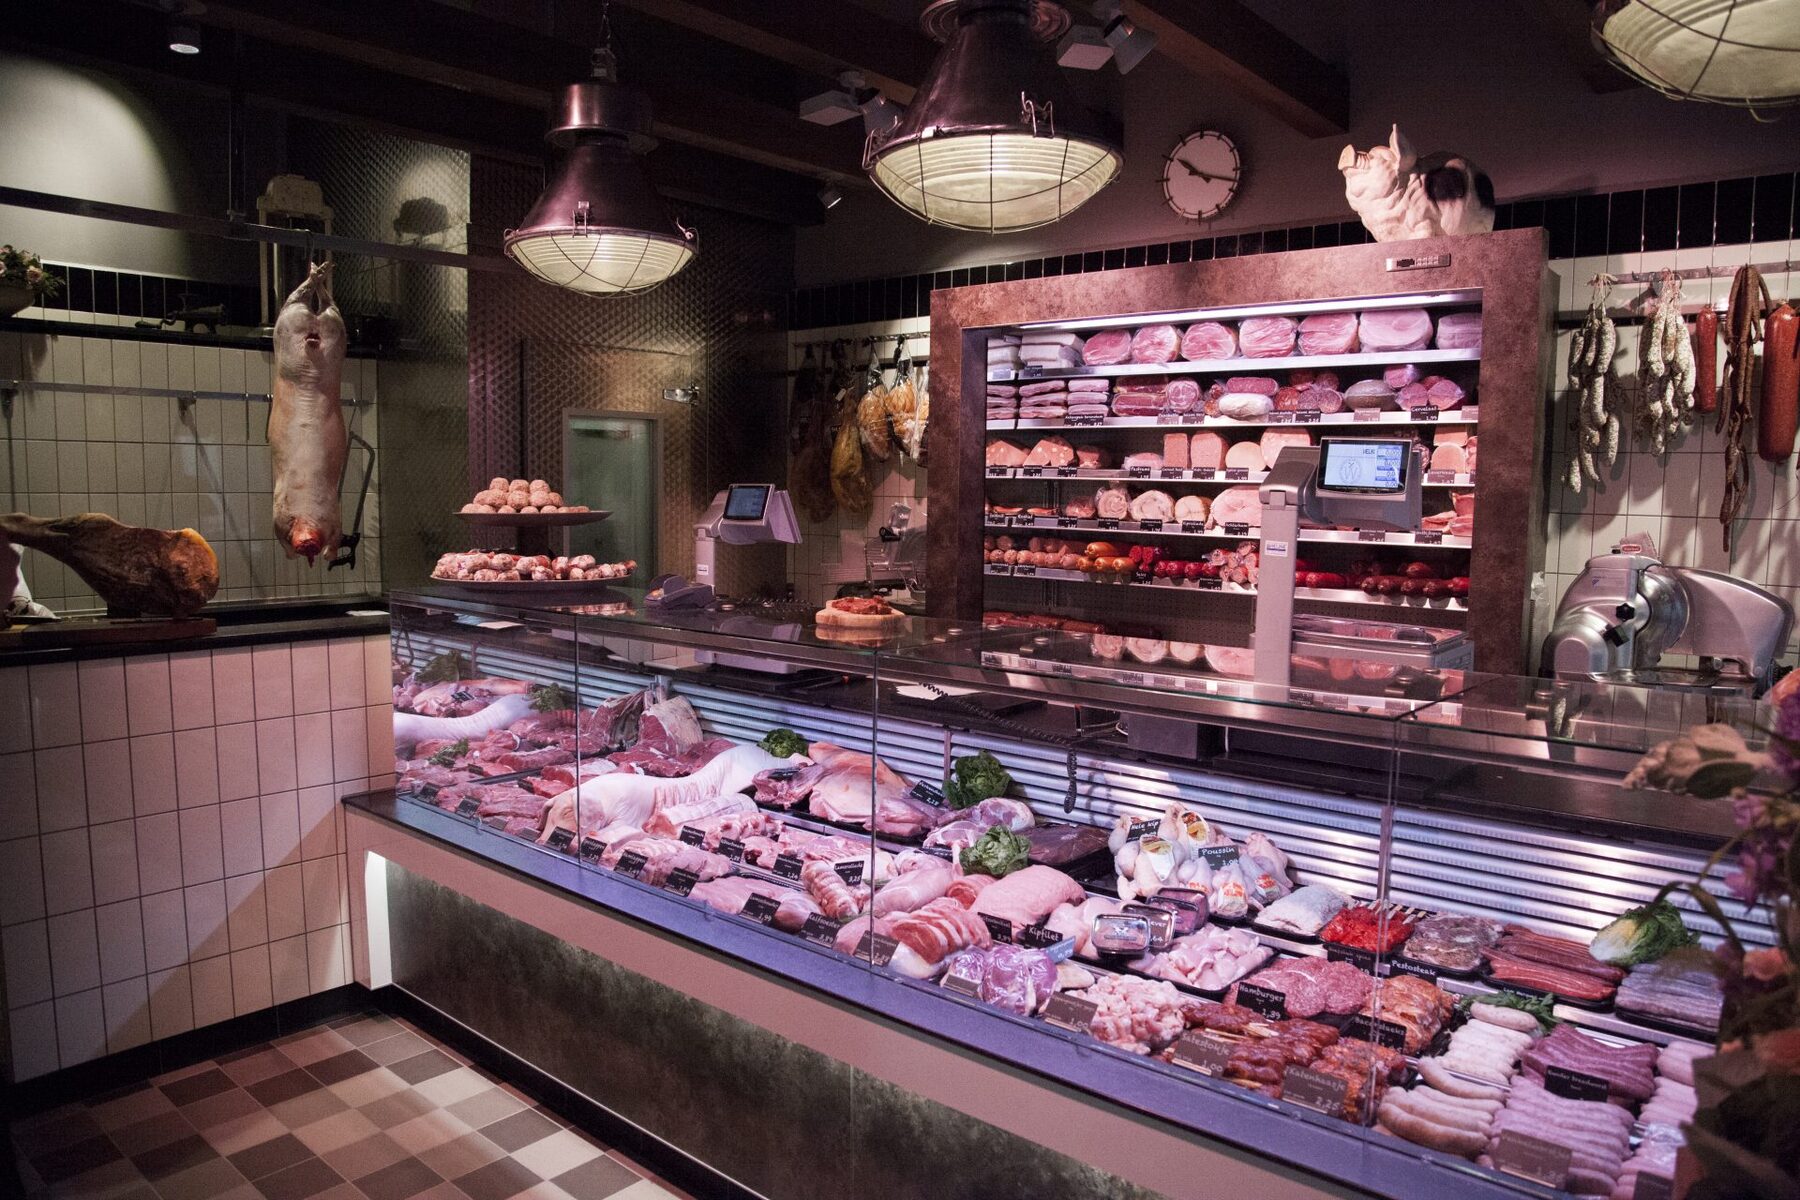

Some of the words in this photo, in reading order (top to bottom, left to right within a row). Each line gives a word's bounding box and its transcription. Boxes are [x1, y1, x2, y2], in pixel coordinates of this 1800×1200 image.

[1201, 847, 1235, 855] Poussin
[1028, 927, 1060, 942] Kipfilet
[1392, 959, 1436, 976] Pestosteak
[1239, 985, 1284, 1001] Hamburger
[1202, 1060, 1223, 1072] 1,00
